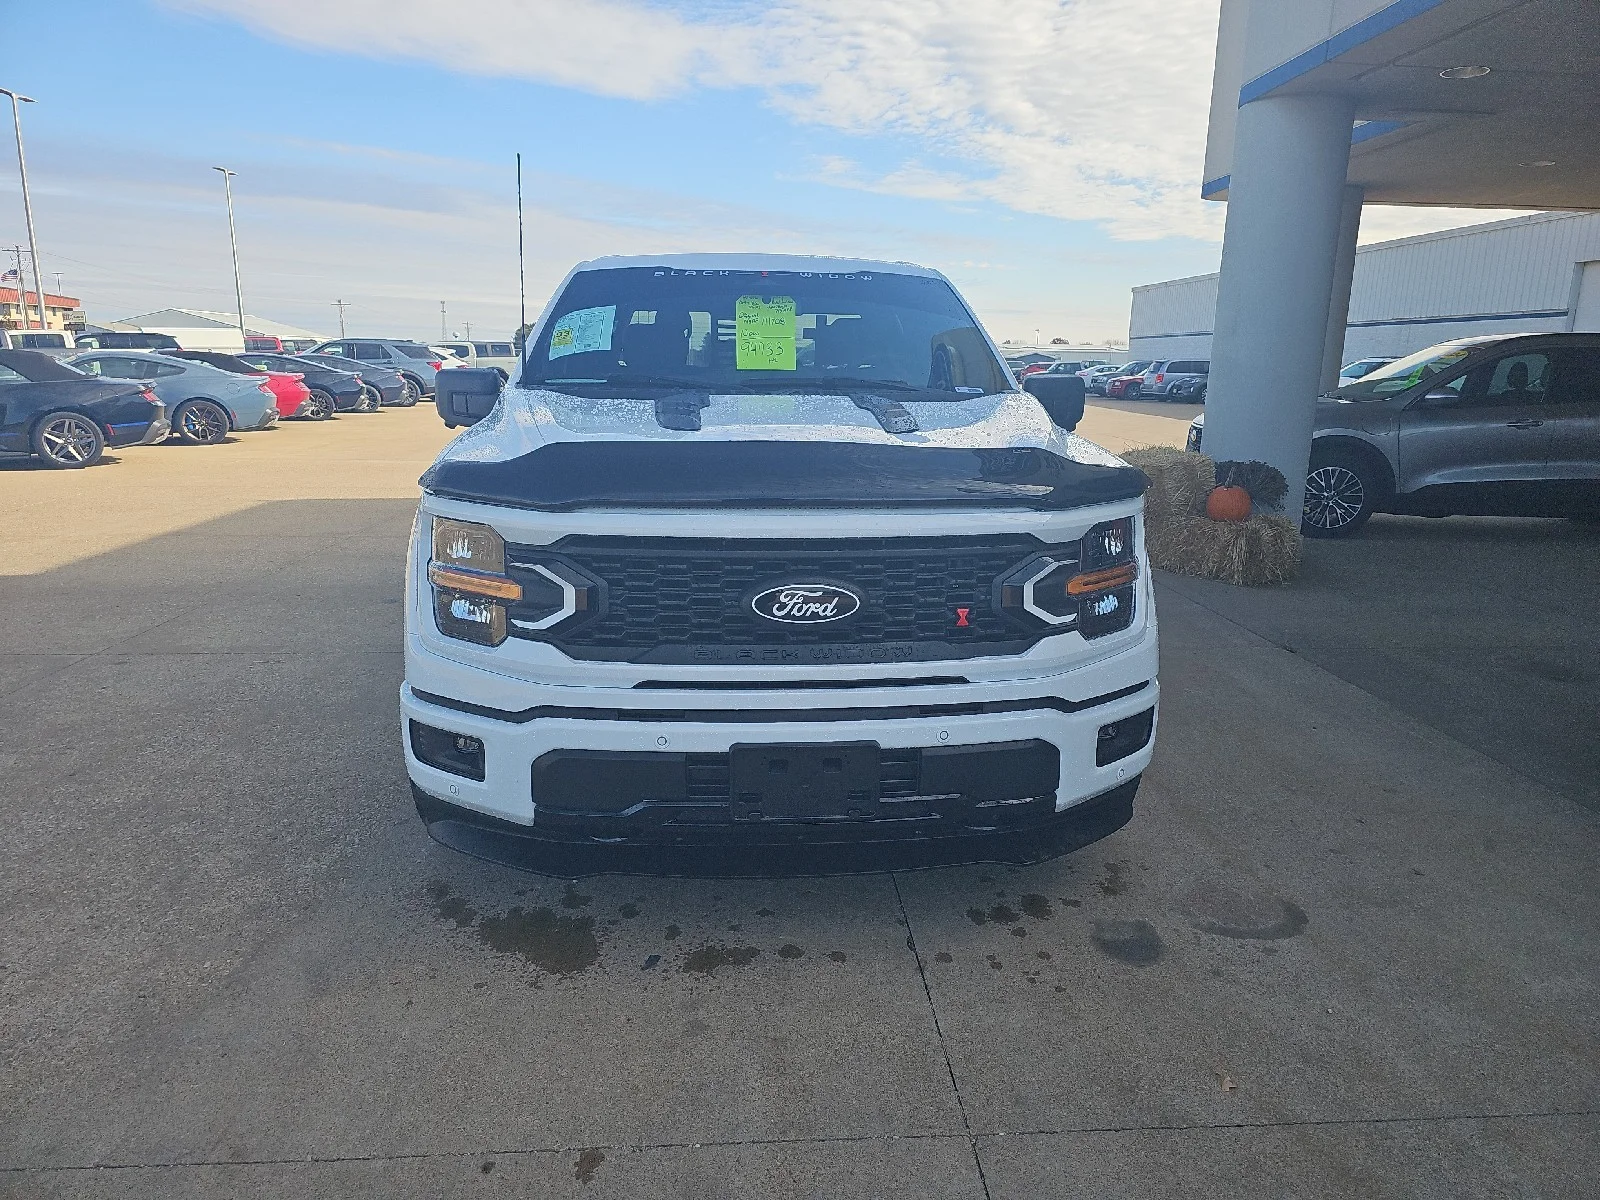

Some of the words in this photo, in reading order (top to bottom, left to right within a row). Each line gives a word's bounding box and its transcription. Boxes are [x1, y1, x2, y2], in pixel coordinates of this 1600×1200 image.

[799, 271, 873, 282] WIDOW
[772, 590, 840, 617] Ford
[693, 648, 799, 661] BLACK
[809, 646, 913, 660] WIDOW
